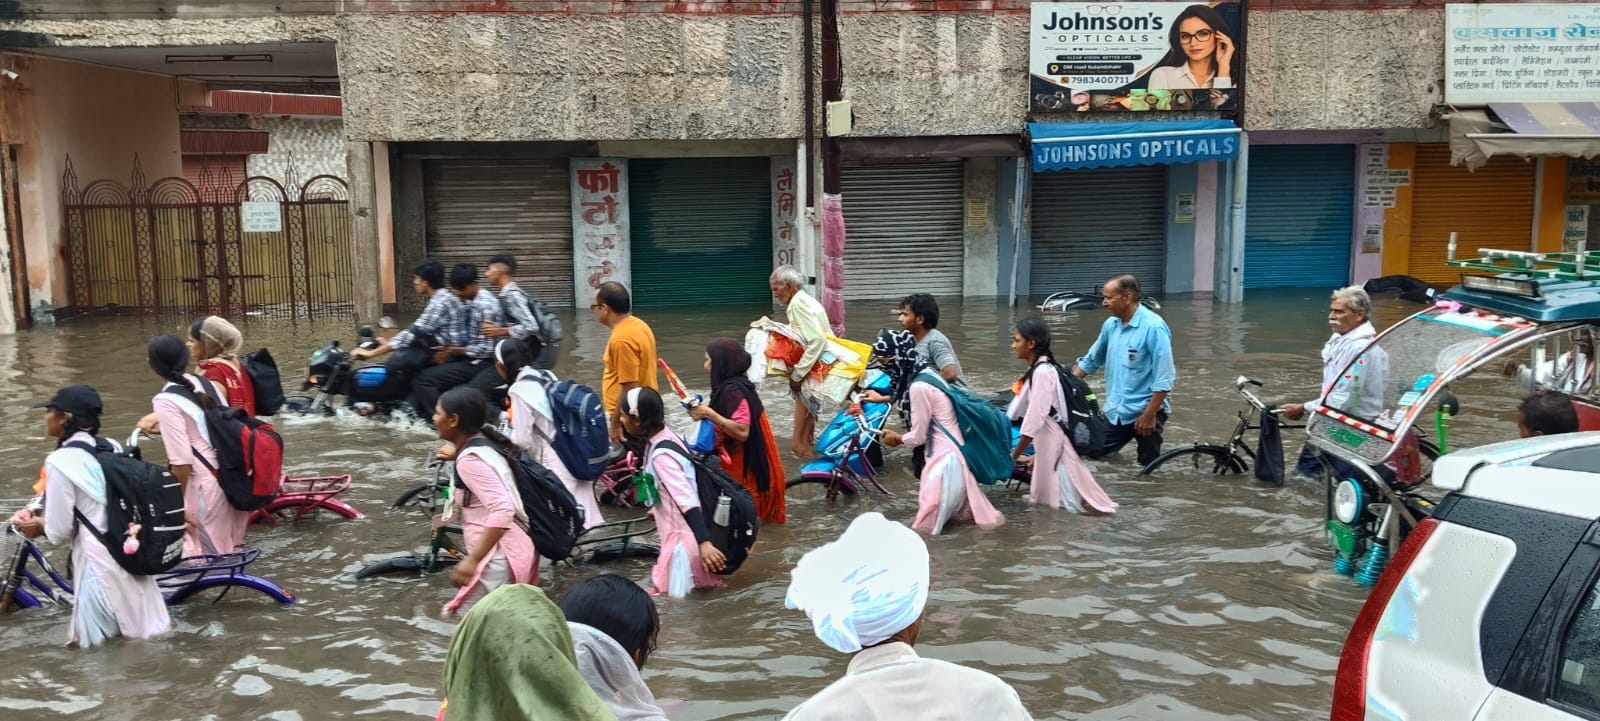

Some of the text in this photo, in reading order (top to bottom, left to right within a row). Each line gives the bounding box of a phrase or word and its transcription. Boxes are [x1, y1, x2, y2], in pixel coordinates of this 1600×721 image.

[1043, 12, 1163, 31] Johnson's
[1058, 34, 1149, 43] OPTICALS
[1564, 22, 1600, 39] सेन
[1072, 76, 1129, 84] 7983400711
[1038, 137, 1235, 164] JOHNSONS OPTICALS
